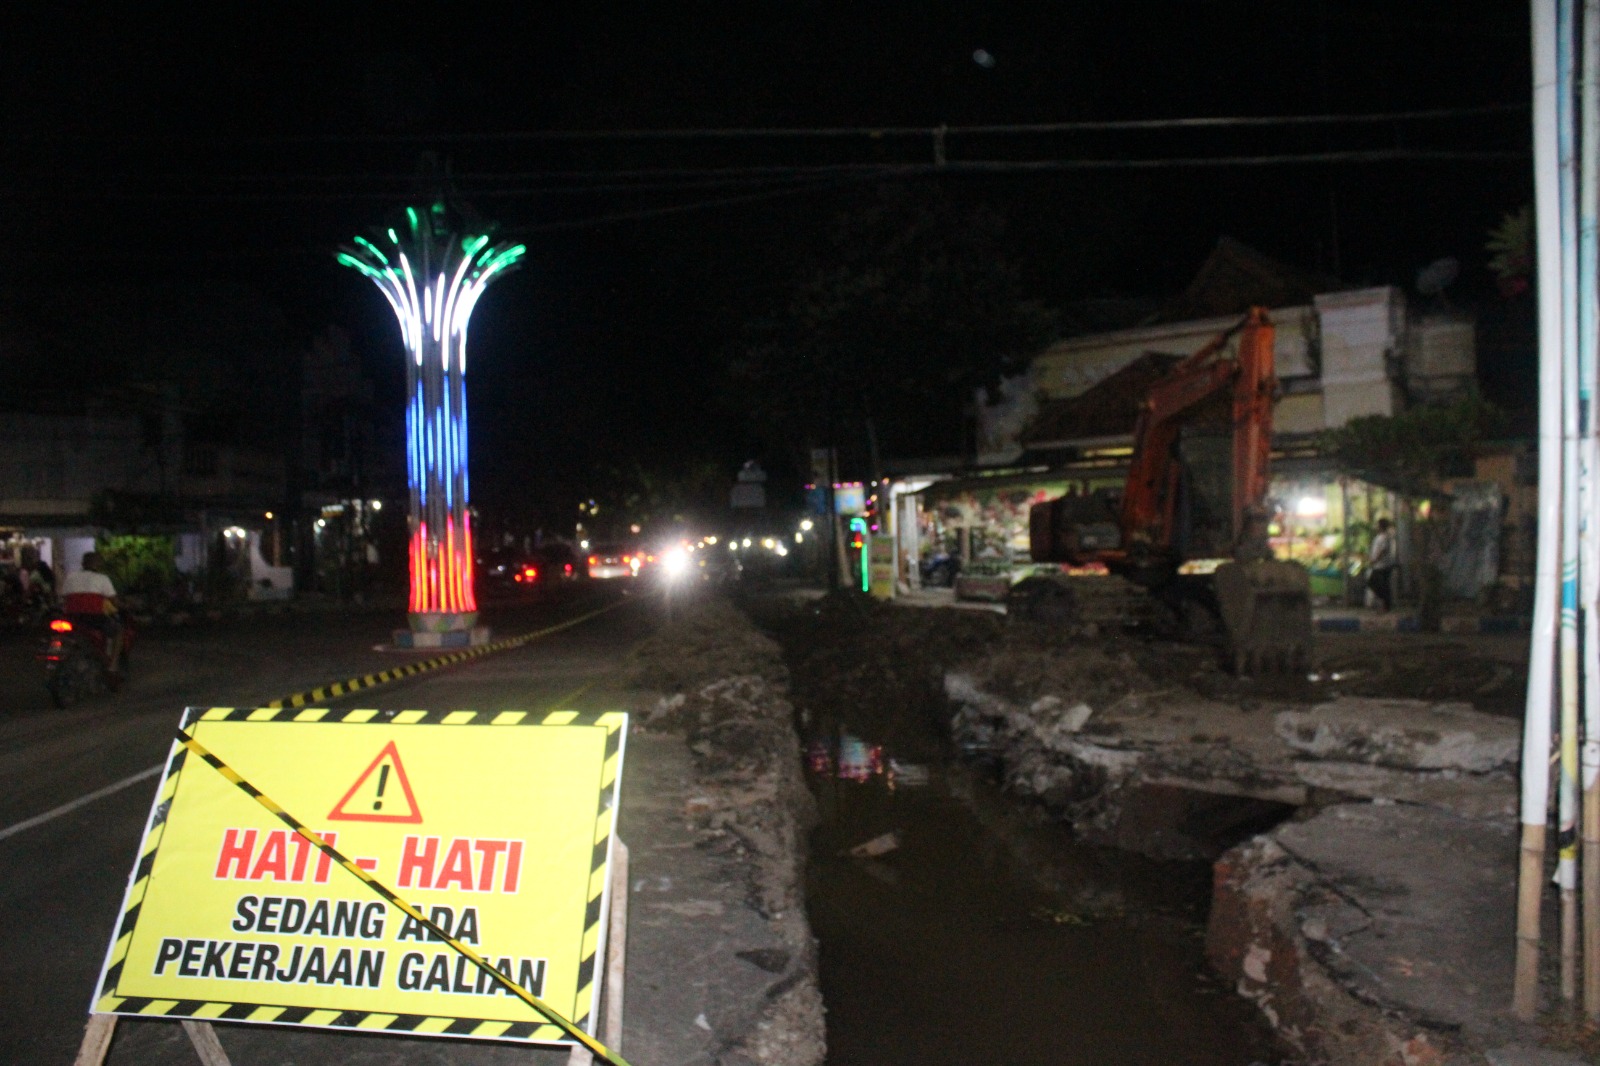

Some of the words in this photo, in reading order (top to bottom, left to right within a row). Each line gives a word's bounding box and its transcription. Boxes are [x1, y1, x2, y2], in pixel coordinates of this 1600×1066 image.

[216, 829, 337, 882] HATI
[355, 859, 377, 870] -
[398, 837, 523, 892] HATI
[232, 896, 386, 938] SEDANG
[398, 905, 479, 944] ADA
[154, 939, 384, 987] PEKERJAAN
[398, 952, 546, 997] GALIAN
